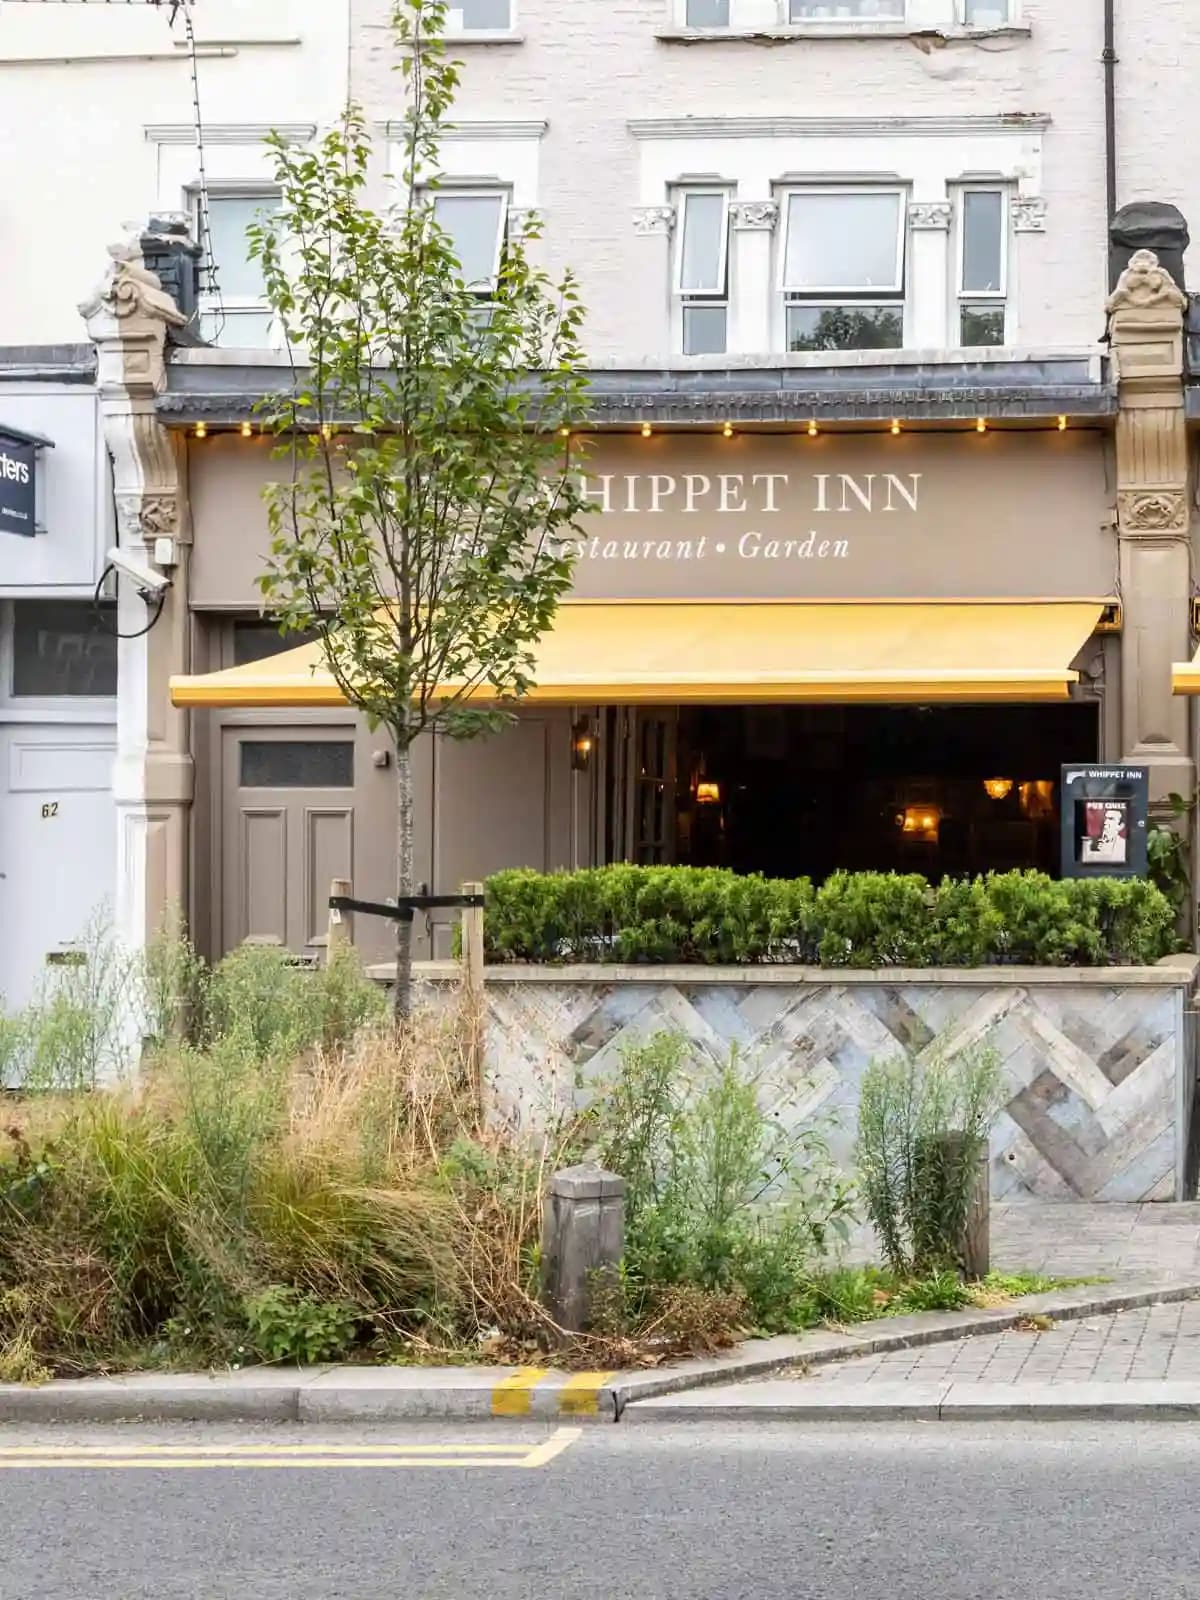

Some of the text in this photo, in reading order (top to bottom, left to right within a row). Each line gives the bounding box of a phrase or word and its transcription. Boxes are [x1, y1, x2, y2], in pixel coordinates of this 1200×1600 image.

[0, 452, 29, 484] ters
[812, 473, 921, 513] INN
[737, 530, 850, 559] Garden
[1088, 770, 1142, 779] WHIPPET INN
[41, 802, 59, 819] 62
